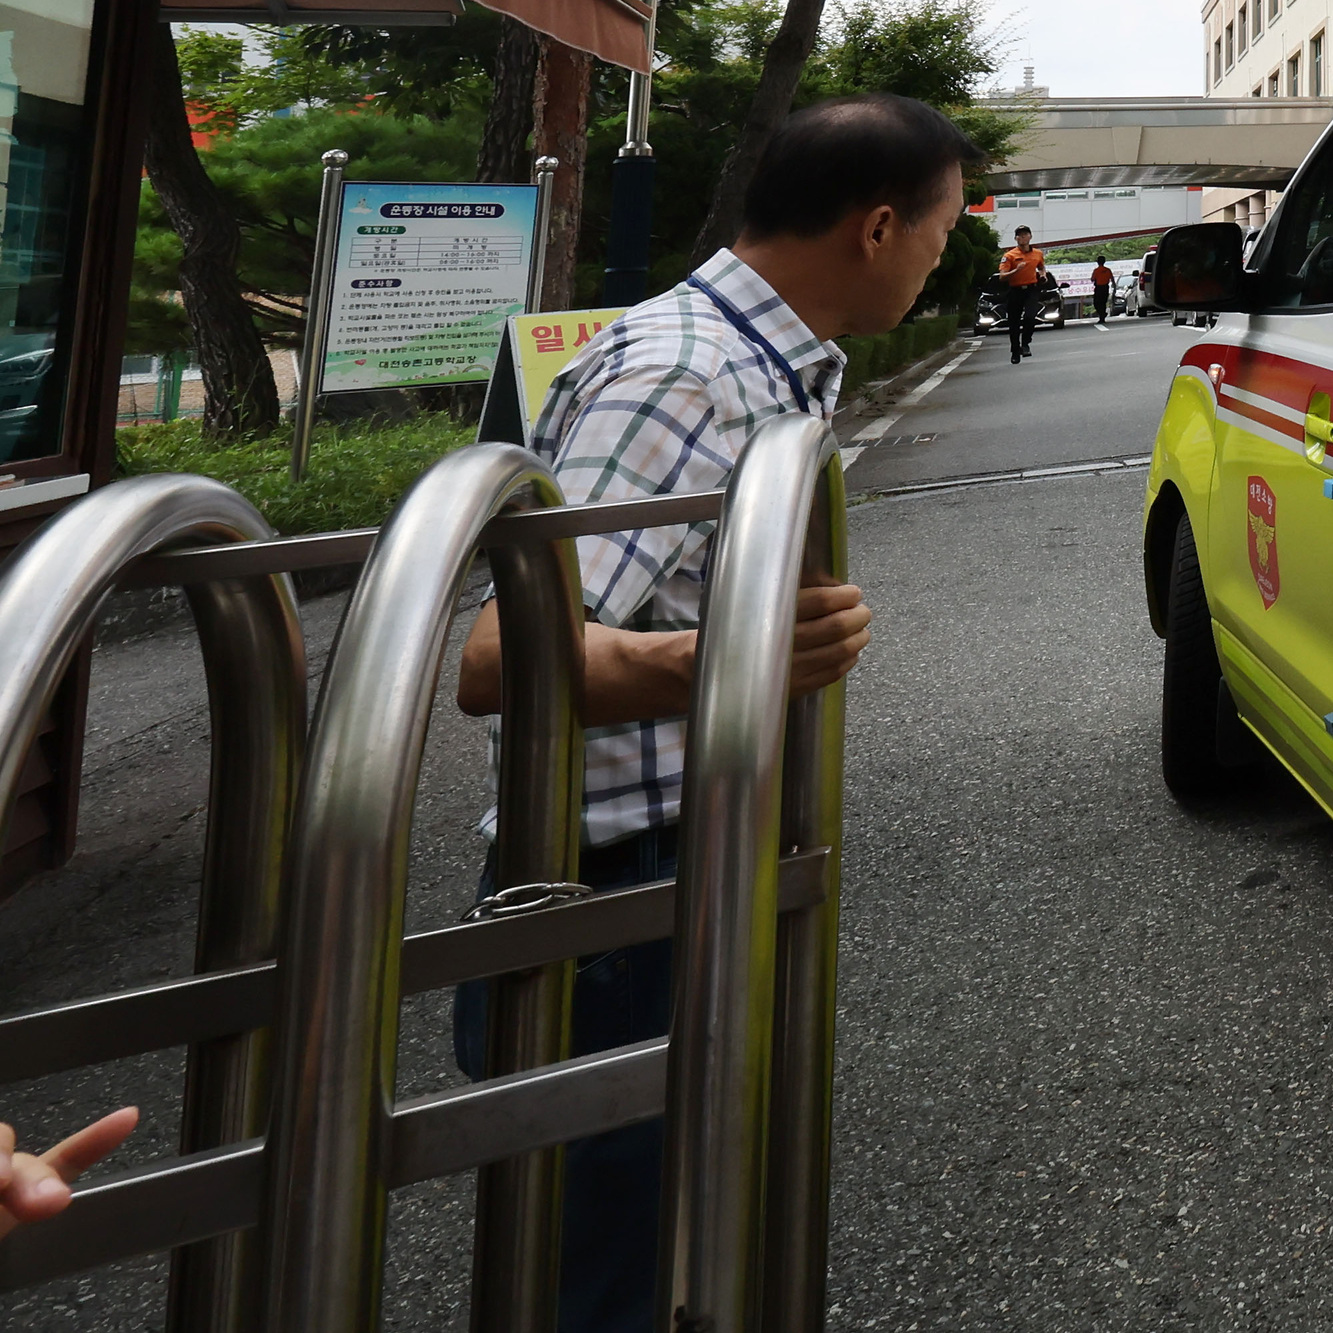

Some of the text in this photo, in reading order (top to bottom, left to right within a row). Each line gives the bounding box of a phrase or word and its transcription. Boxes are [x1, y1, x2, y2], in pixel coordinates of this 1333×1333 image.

[390, 205, 496, 216] 운동장 시설 이용 안내
[378, 355, 477, 369] 대전송촌고등학교장
[1250, 483, 1273, 515] 대전소방
